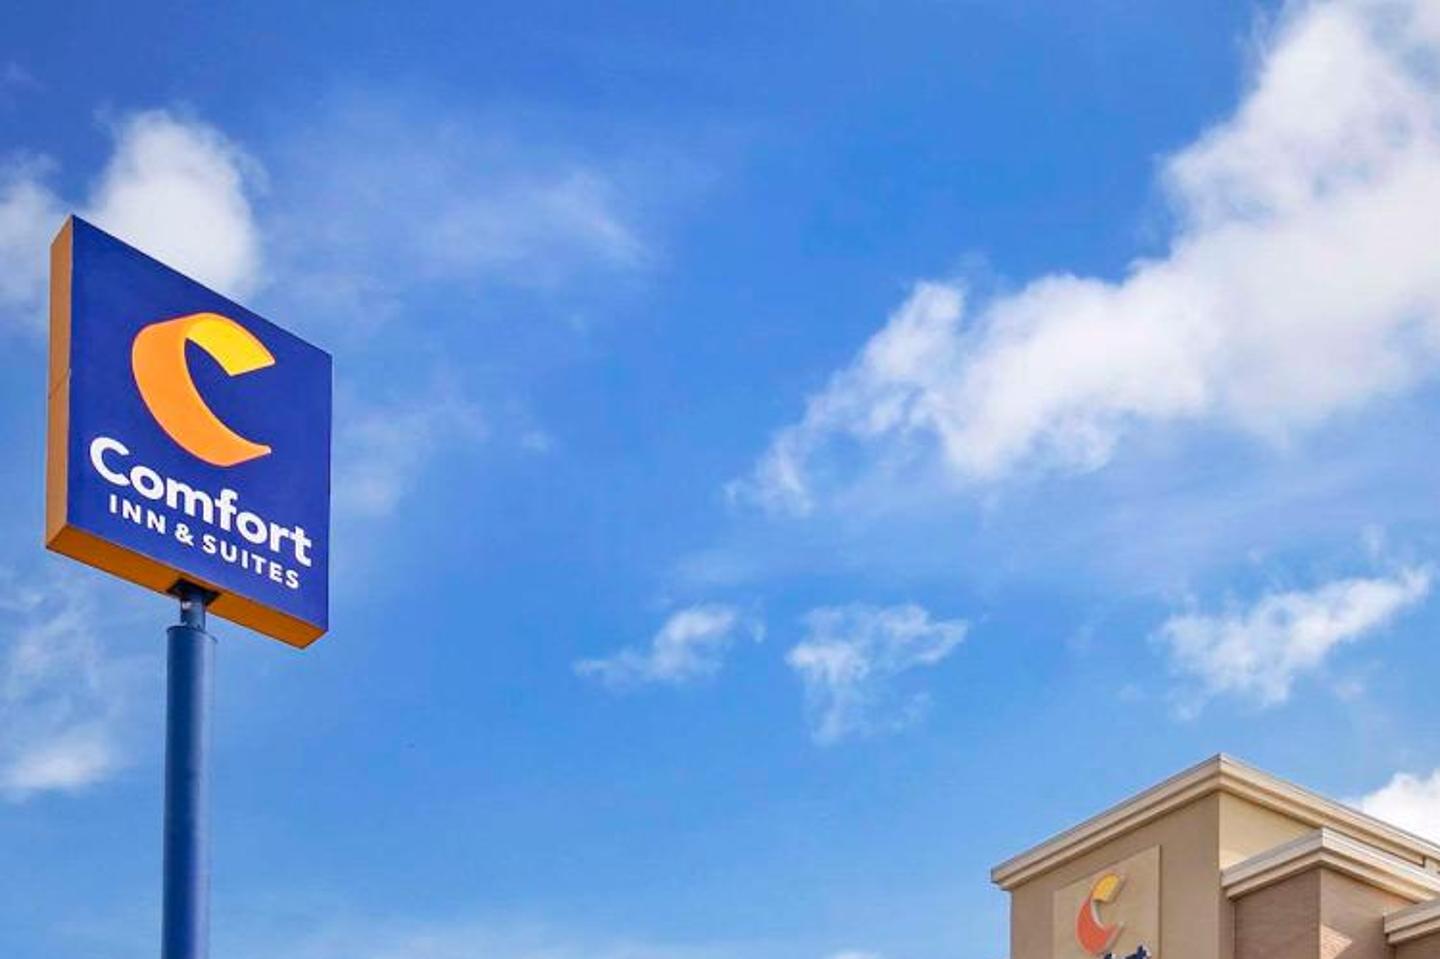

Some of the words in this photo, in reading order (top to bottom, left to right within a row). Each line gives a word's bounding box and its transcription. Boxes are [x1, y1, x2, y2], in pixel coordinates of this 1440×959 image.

[90, 437, 311, 567] Comfort
[109, 495, 167, 533] INN
[174, 523, 194, 547] &
[202, 538, 299, 589] SUITES
